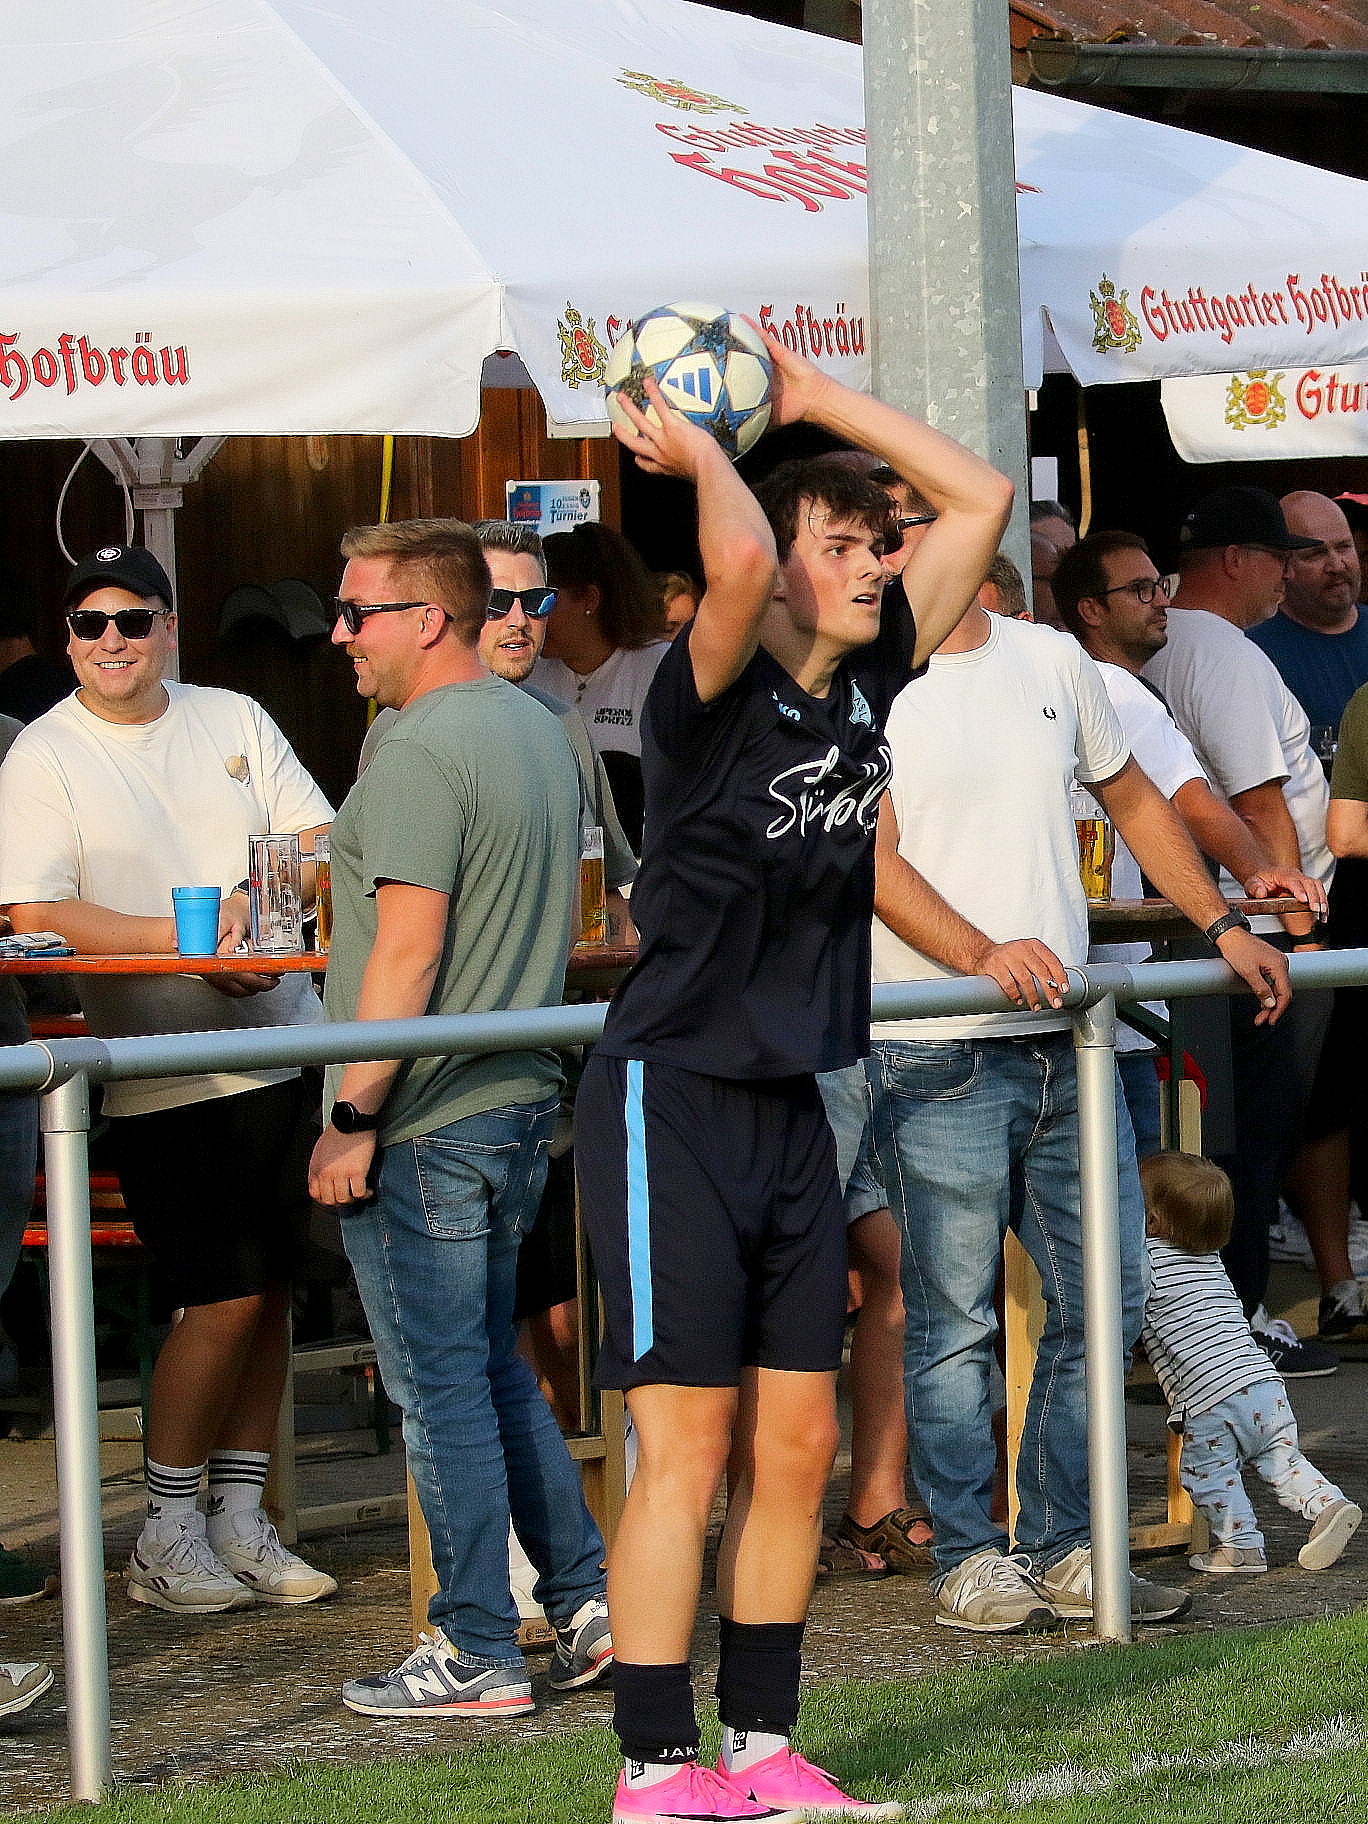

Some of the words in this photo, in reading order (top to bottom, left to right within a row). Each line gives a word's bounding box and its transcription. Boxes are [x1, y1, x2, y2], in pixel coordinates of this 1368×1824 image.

[655, 121, 867, 152] Stuttgarte
[1140, 281, 1289, 344] Stuttgarter
[549, 509, 588, 523] Turnier
